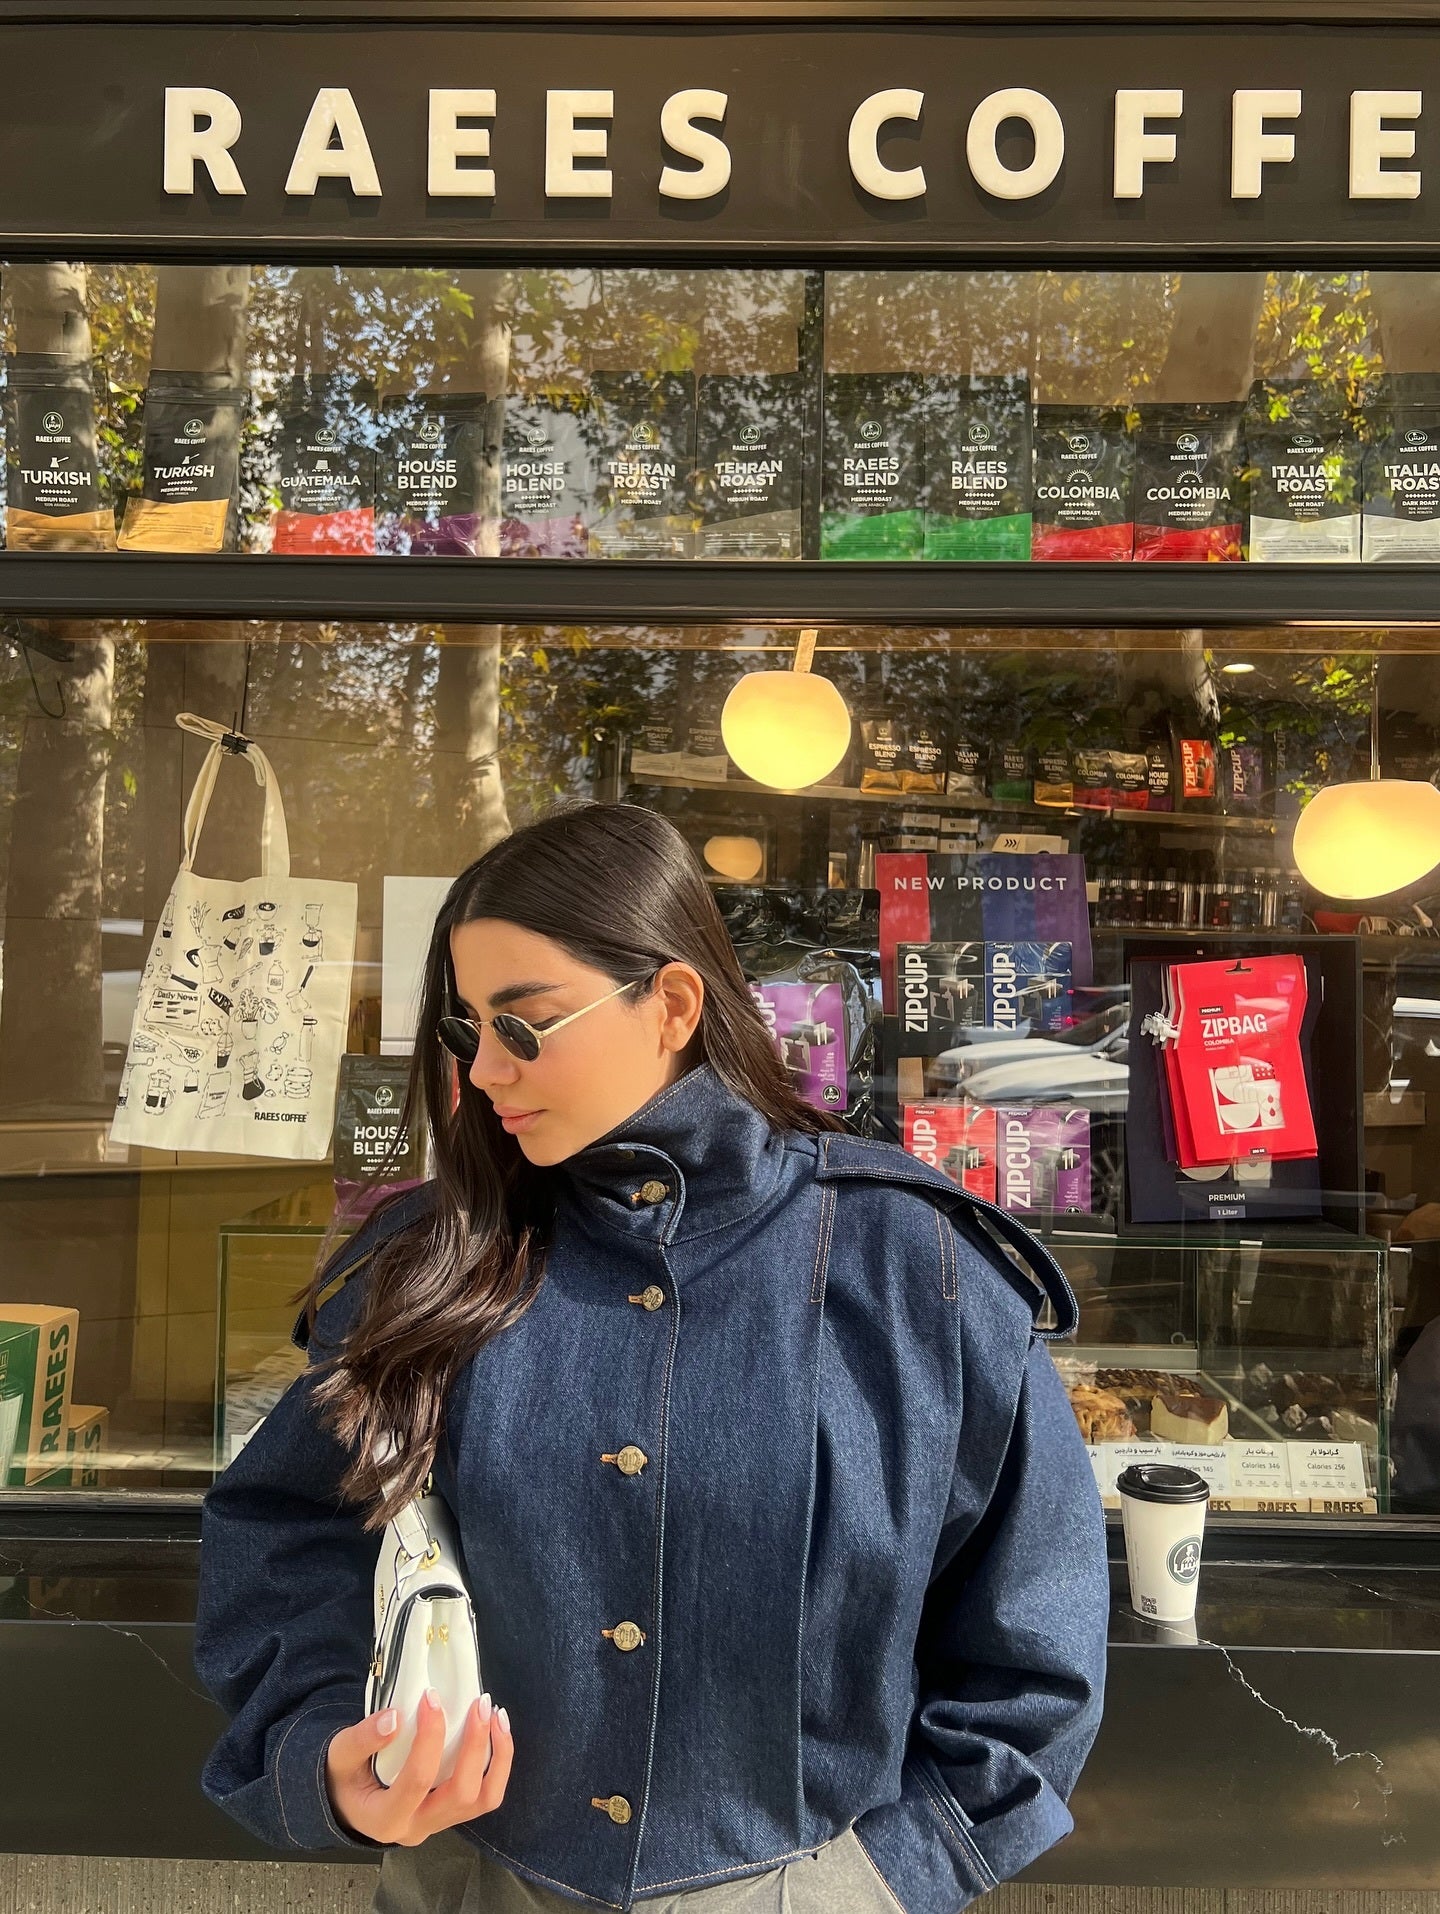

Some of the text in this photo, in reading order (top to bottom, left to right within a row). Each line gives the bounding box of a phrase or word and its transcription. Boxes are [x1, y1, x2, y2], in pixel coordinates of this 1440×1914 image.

[163, 86, 1423, 200] RAEES COFFE
[398, 460, 456, 473] HOUSE
[506, 463, 564, 476] HOUSE
[608, 462, 675, 477] TEHRAN
[714, 461, 782, 474] TEHRAN
[844, 458, 899, 470] RAEES
[952, 461, 1007, 474] RAEES
[21, 470, 91, 485] TURKISH
[154, 466, 215, 479] TURKISH
[1272, 465, 1340, 478] ITALIAN
[281, 475, 361, 487] GUATEMALA
[398, 475, 457, 489] BLEND
[506, 478, 565, 492] BLEND
[614, 476, 669, 489] ROAST
[720, 474, 776, 487] ROAST
[844, 473, 899, 486] BLEND
[952, 477, 1007, 489] BLEND
[1277, 479, 1336, 492] ROAST
[1391, 478, 1440, 491] ROAS
[1037, 487, 1120, 500] COLOMBIA
[1147, 487, 1230, 500] COLOMBIA
[869, 743, 901, 751] ESPRESSO
[909, 746, 941, 755] ESPRESSO
[915, 753, 936, 761] BLEND
[1004, 762, 1024, 770] BLEND
[1183, 742, 1195, 786] ZIPCUP
[1078, 769, 1107, 778] COLOMBIA
[1116, 773, 1144, 781] COLOMBIA
[1149, 771, 1169, 779] HOUSE
[1231, 750, 1244, 792] ZIPCUP
[1149, 778, 1168, 786] BLEND
[894, 877, 1067, 890] NEW PRODUCT
[905, 953, 928, 1033] ZIPCUP
[993, 953, 1017, 1032] ZIPCUP
[1201, 1014, 1268, 1038] ZIPBAG
[254, 1112, 307, 1122] RAEES COFFEE
[913, 1118, 937, 1168] CUP
[1006, 1120, 1031, 1209] ZIPCUP
[40, 1324, 70, 1458] RAEES
